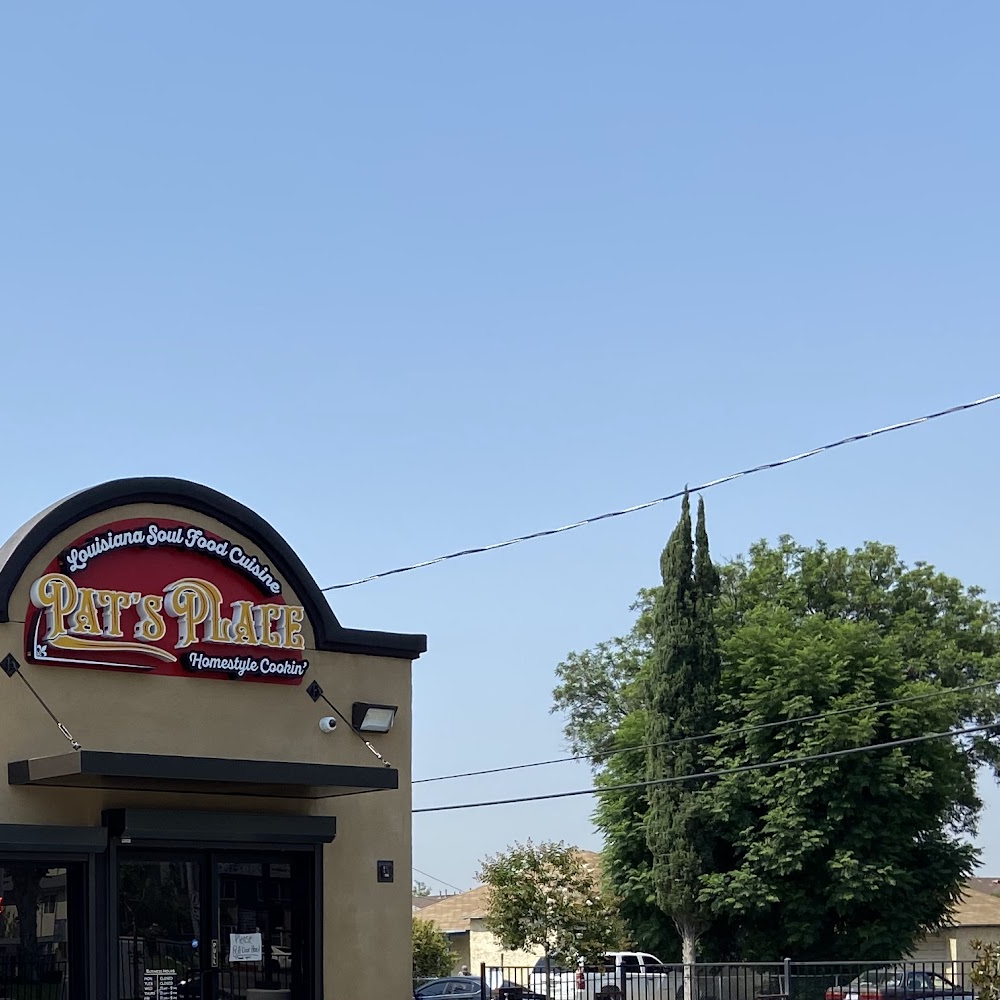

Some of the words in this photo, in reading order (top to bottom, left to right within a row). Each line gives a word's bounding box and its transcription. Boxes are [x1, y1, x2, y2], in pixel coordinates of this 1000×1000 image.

[66, 529, 145, 573] Louisiana
[147, 524, 184, 546] Soul
[185, 528, 229, 558] Food
[229, 547, 282, 594] Cuisine
[30, 572, 167, 642] PAT'S
[163, 577, 306, 650] PLACE
[189, 652, 259, 677] Homestyle
[259, 658, 309, 676] Cookin'
